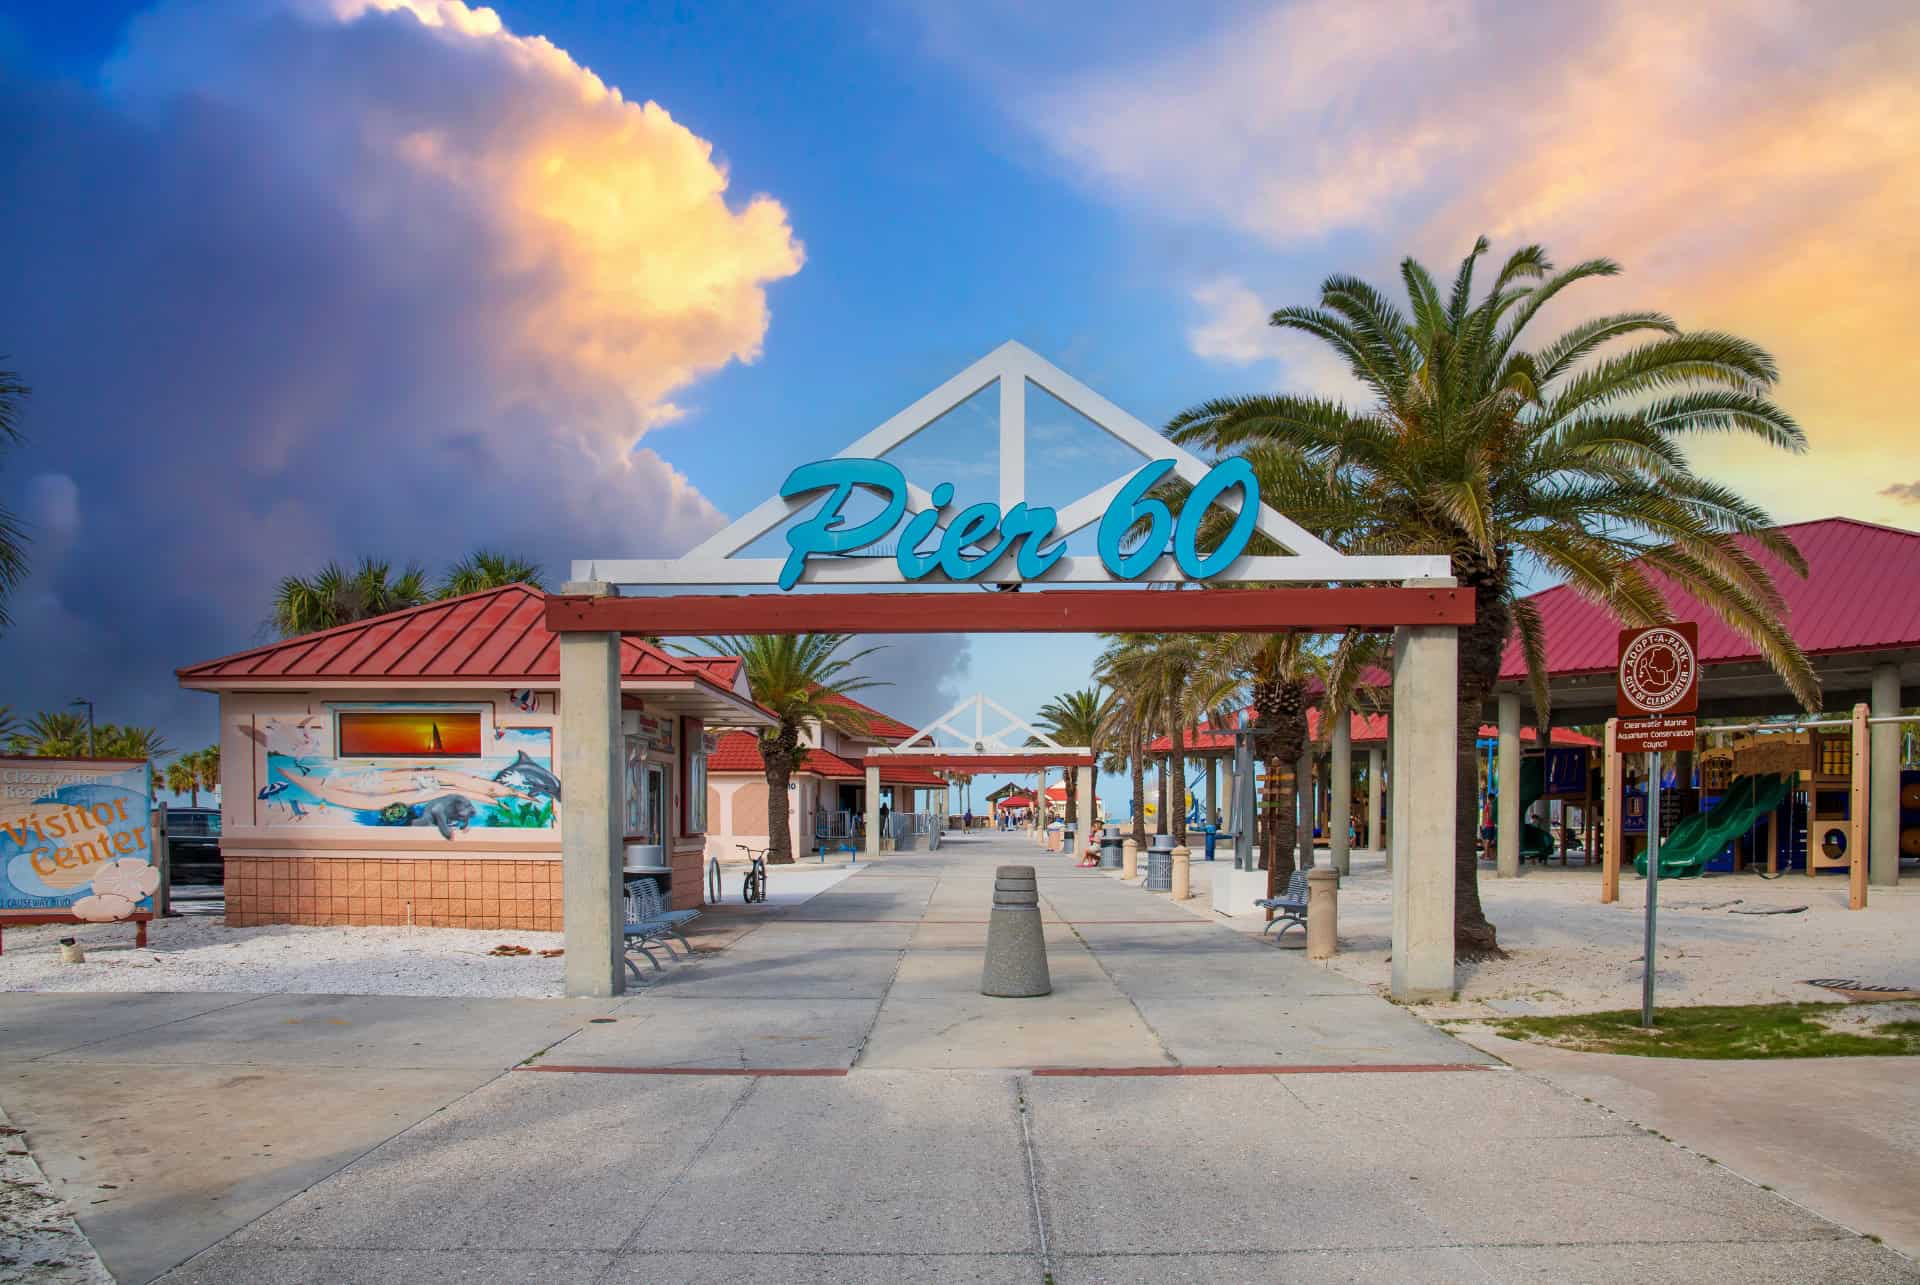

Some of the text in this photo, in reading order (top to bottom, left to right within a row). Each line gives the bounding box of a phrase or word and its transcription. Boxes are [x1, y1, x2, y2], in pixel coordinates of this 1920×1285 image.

[779, 456, 1260, 591] Pier 60
[1627, 634, 1689, 667] ADOPT-A-PARK
[1626, 671, 1689, 705] CITY OF CLEARWATER
[1617, 730, 1694, 740] Aquarium Conservation
[1624, 719, 1688, 729] Clearwater Marine
[1642, 741, 1668, 749] Council
[6, 784, 58, 799] Beach
[0, 797, 129, 847] Visitor
